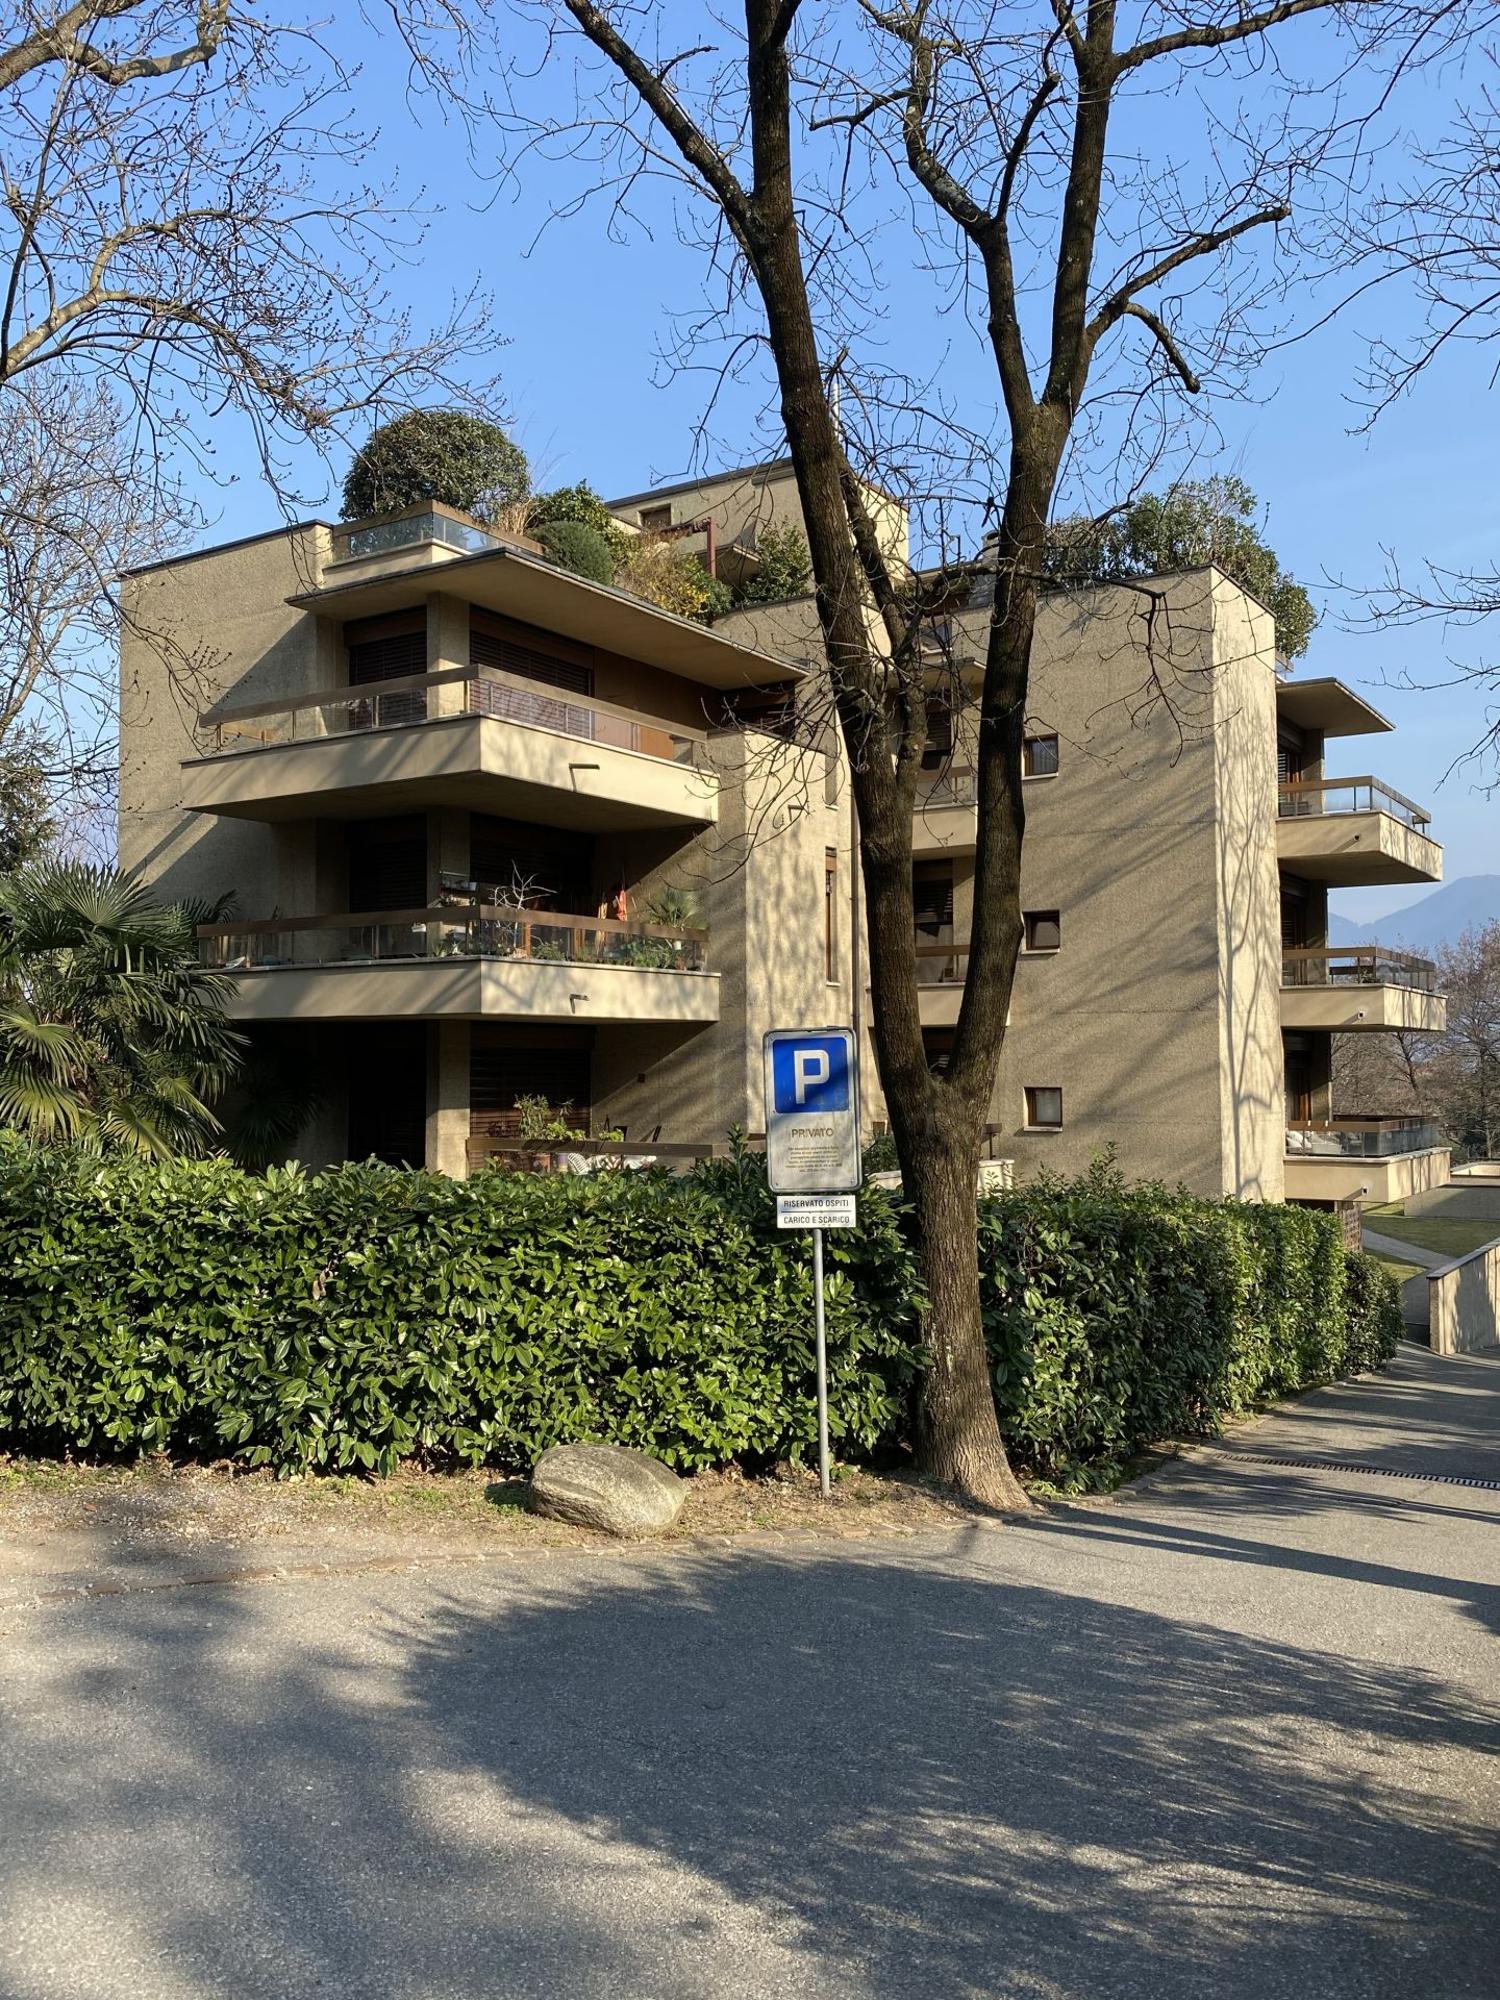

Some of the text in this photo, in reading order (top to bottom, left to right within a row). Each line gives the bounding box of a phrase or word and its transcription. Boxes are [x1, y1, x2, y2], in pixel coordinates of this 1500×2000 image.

[793, 1049, 830, 1105] P
[791, 1127, 834, 1138] PRIVATO
[783, 1199, 849, 1208] RISERVATO OSPITI
[783, 1216, 850, 1224] CARICO E SCARICO
